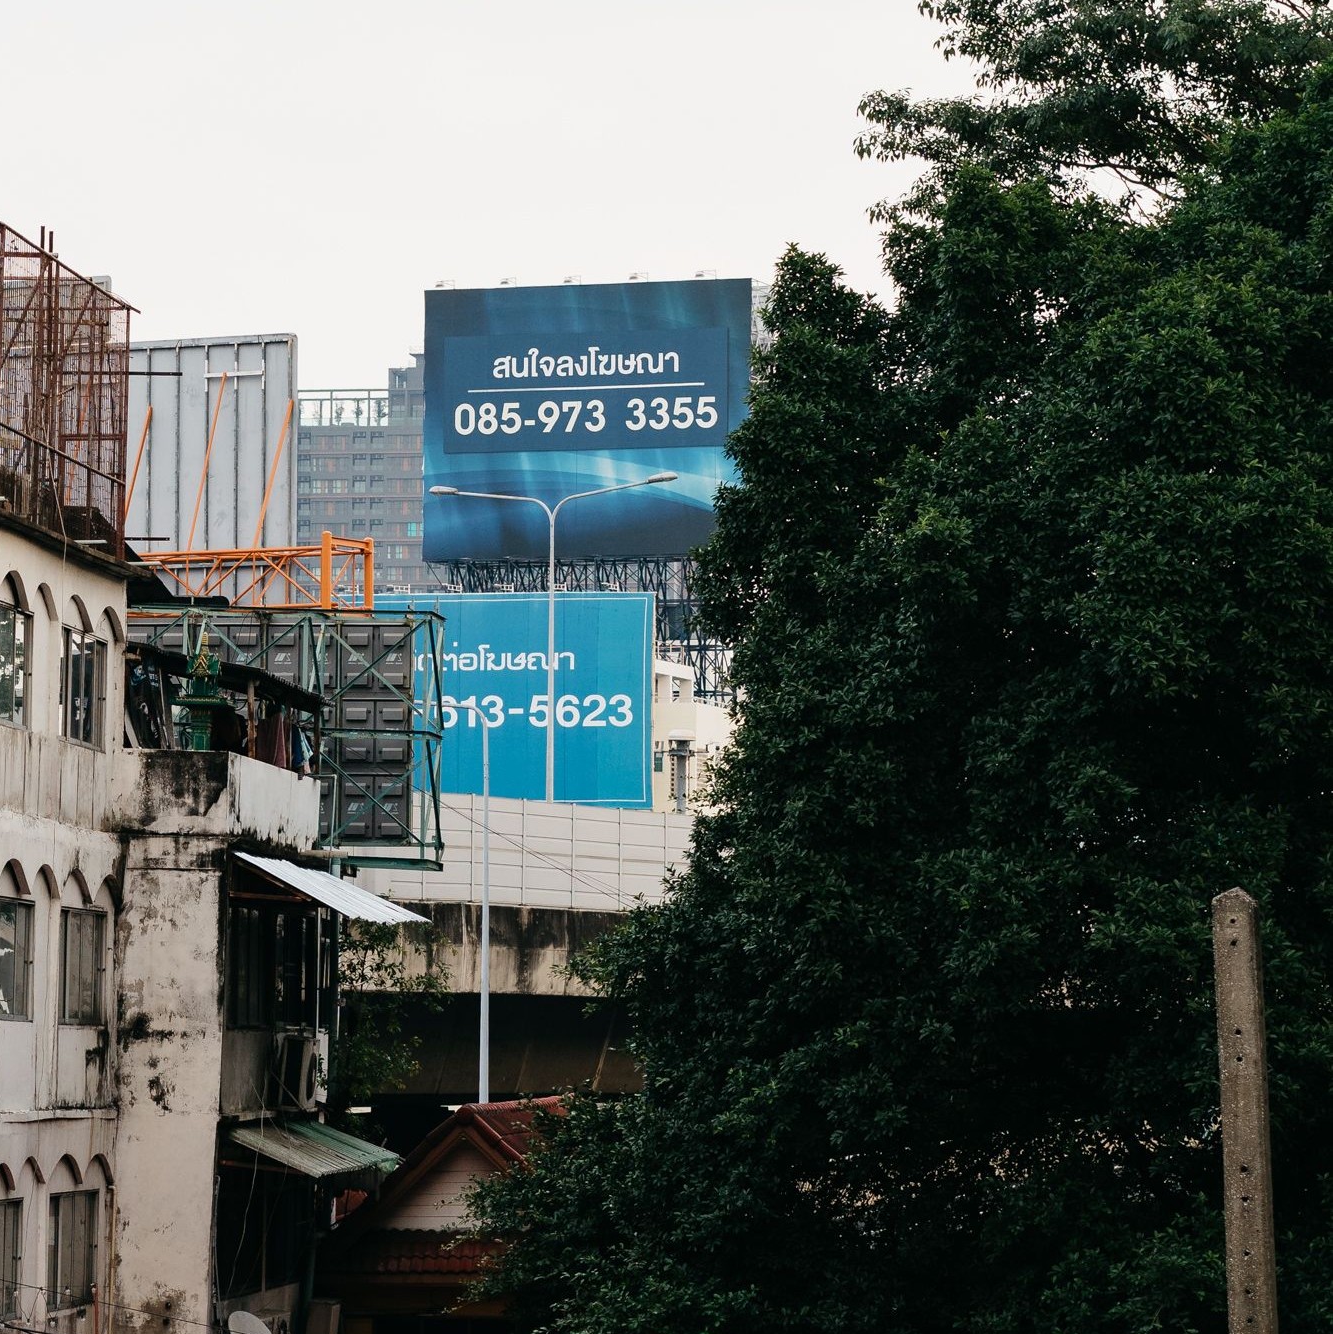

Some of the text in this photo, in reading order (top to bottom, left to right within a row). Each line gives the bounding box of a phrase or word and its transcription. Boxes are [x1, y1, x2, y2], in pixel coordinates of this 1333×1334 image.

[493, 347, 680, 379] สนใจลงโฆษณา
[454, 396, 718, 436] 085-973 3355
